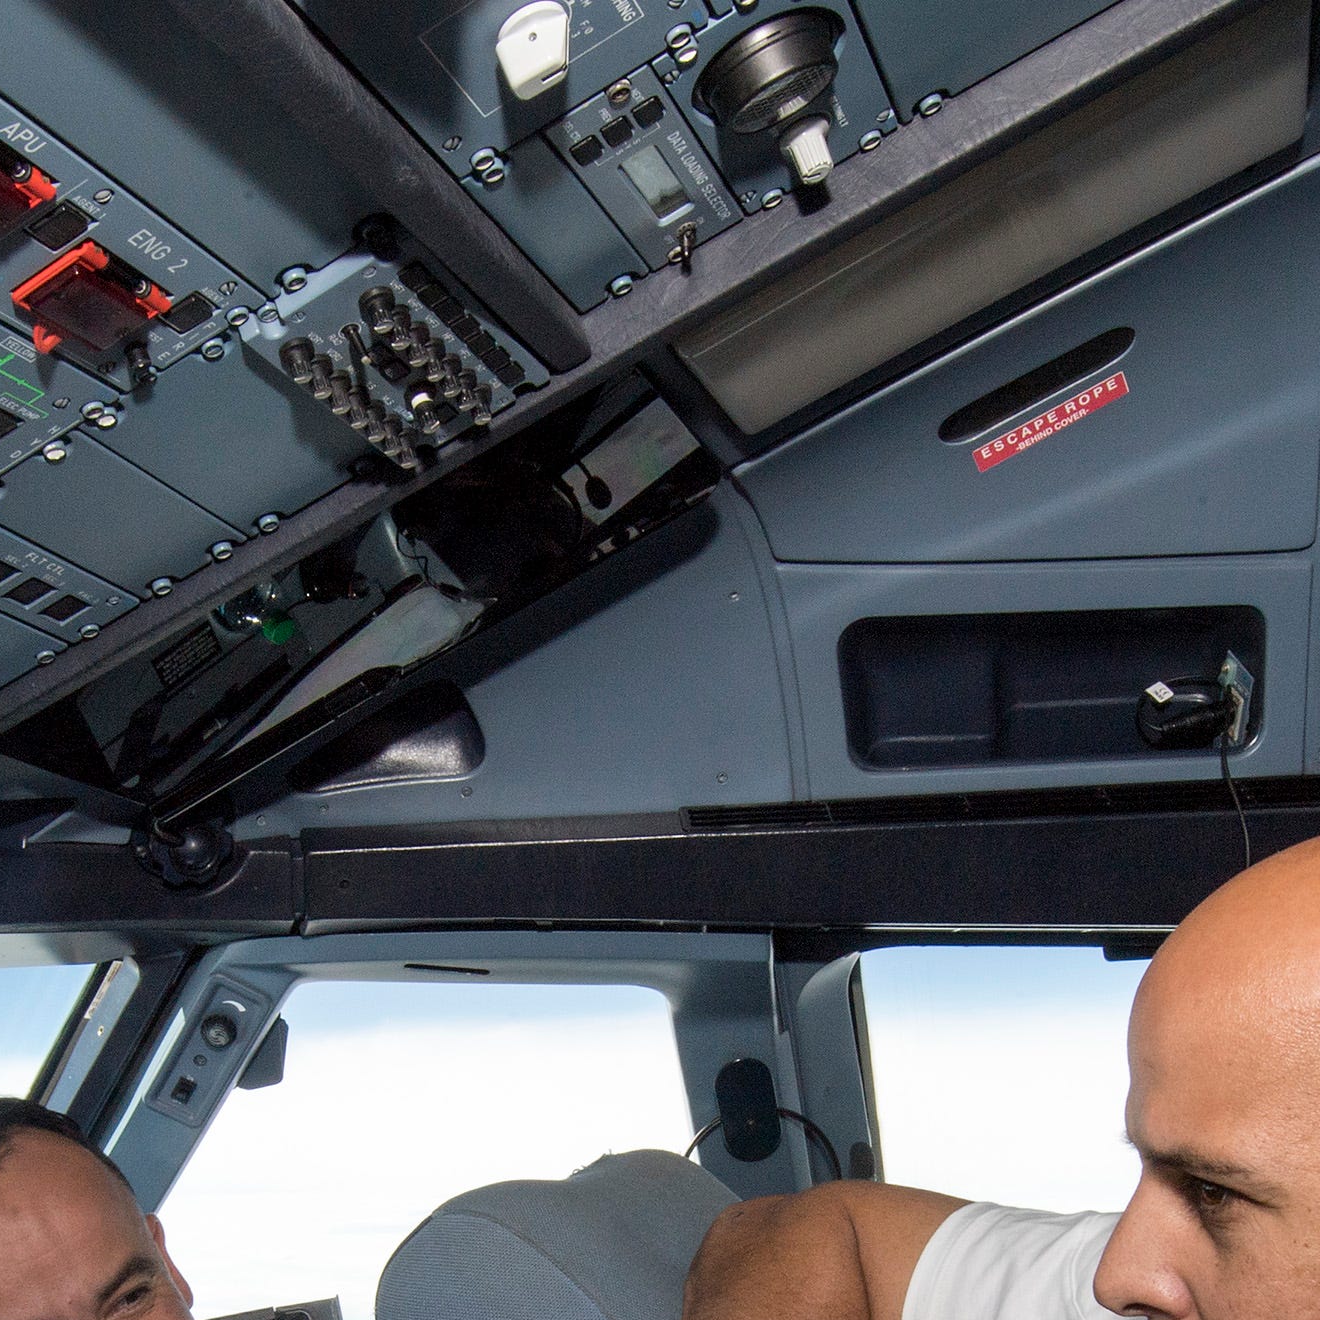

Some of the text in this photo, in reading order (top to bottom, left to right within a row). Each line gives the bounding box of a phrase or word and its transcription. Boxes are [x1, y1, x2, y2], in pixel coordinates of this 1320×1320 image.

[666, 131, 732, 221] DATA LOADING SELECTOR
[74, 194, 101, 216] AGENT
[128, 228, 188, 274] ENG 2
[5, 338, 37, 360] YELLOW
[980, 377, 1119, 460] ESCAPE ROPE
[1015, 408, 1090, 452] -BEHIND COVER-
[24, 552, 66, 576] FLT CTL
